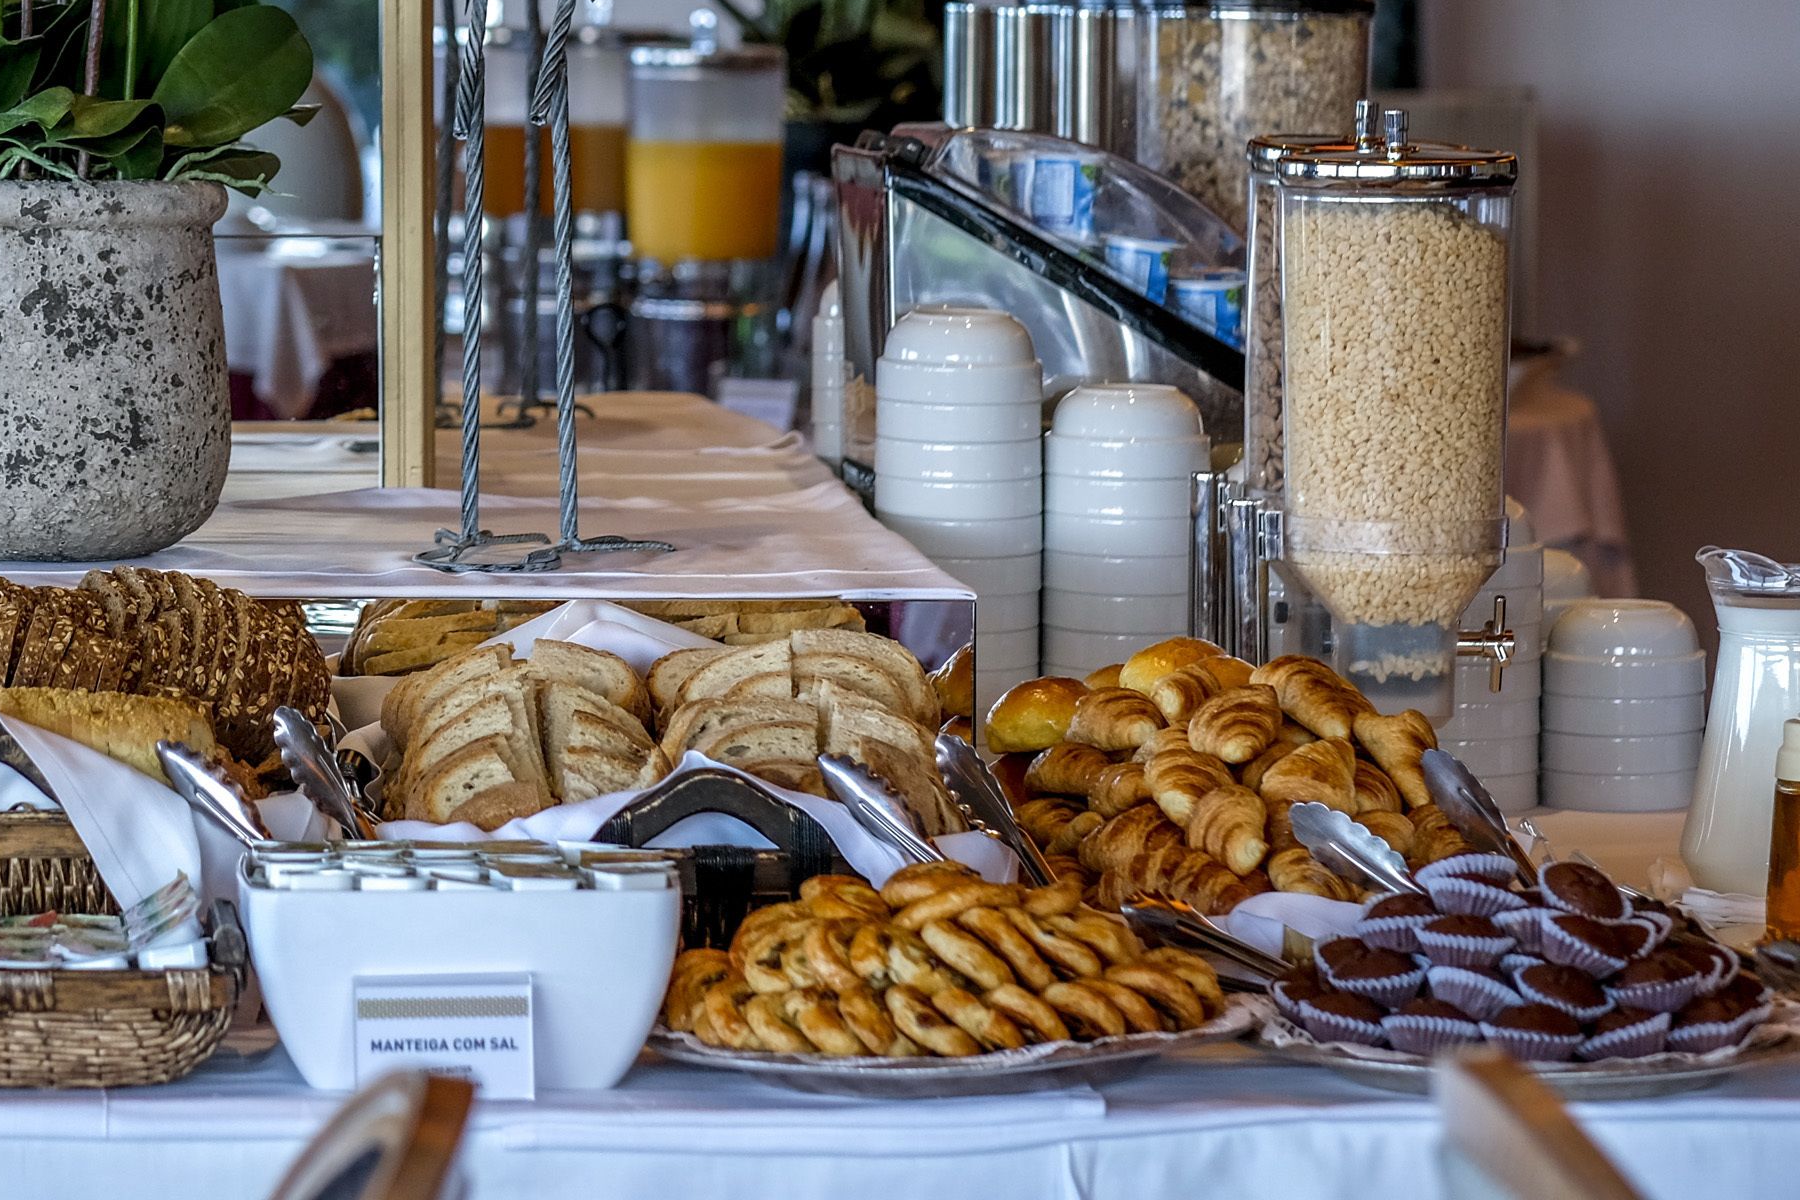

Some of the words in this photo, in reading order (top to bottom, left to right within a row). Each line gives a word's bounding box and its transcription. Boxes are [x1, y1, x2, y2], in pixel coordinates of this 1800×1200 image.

[371, 1038, 449, 1052] MANTEIGA
[453, 1037, 485, 1051] COM
[490, 1036, 519, 1051] SAL
